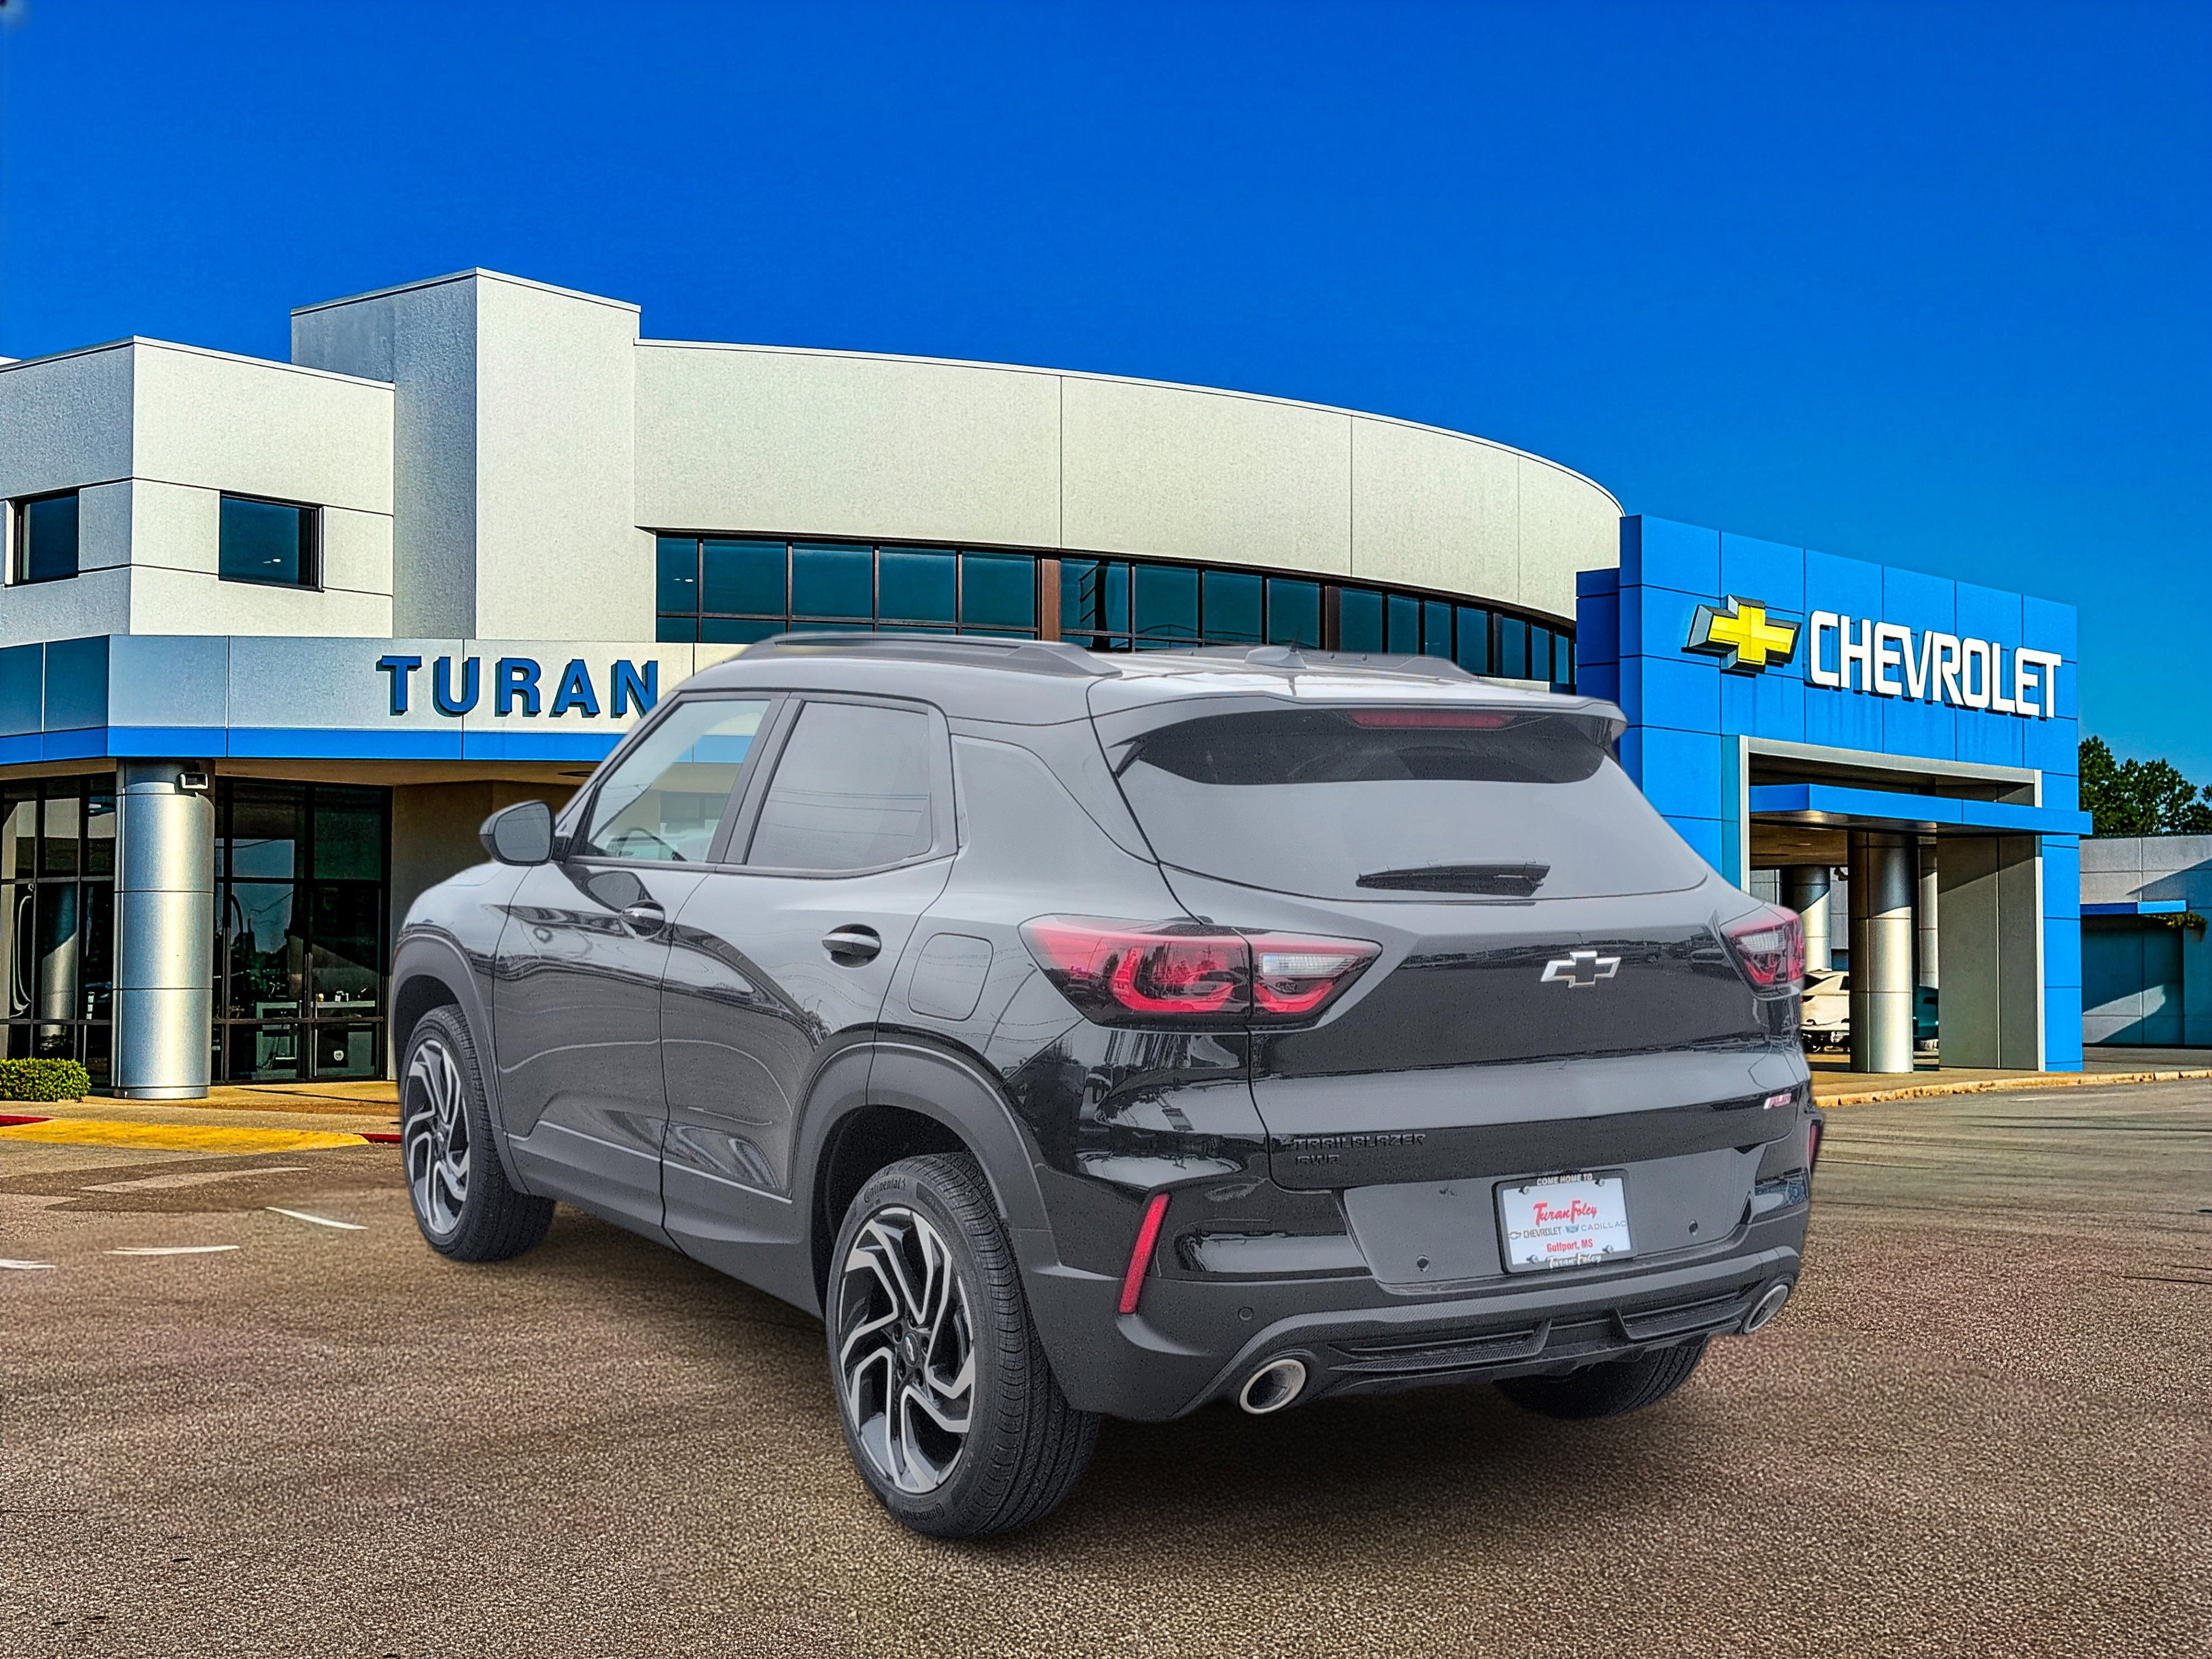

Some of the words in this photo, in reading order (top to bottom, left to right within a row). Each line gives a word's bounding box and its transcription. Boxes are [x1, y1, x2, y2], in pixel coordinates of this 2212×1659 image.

[1810, 609, 2061, 719] CHEVROLET
[376, 655, 658, 719] TURAN
[1536, 1176, 1559, 1186] COME
[1560, 1174, 1581, 1184] HOME
[1583, 1173, 1593, 1181] TO
[1523, 1226, 1562, 1239] CHEVROLET
[1580, 1220, 1627, 1232] CADILLAC
[1546, 1239, 1580, 1253] Gulfport,
[1581, 1238, 1593, 1248] MS
